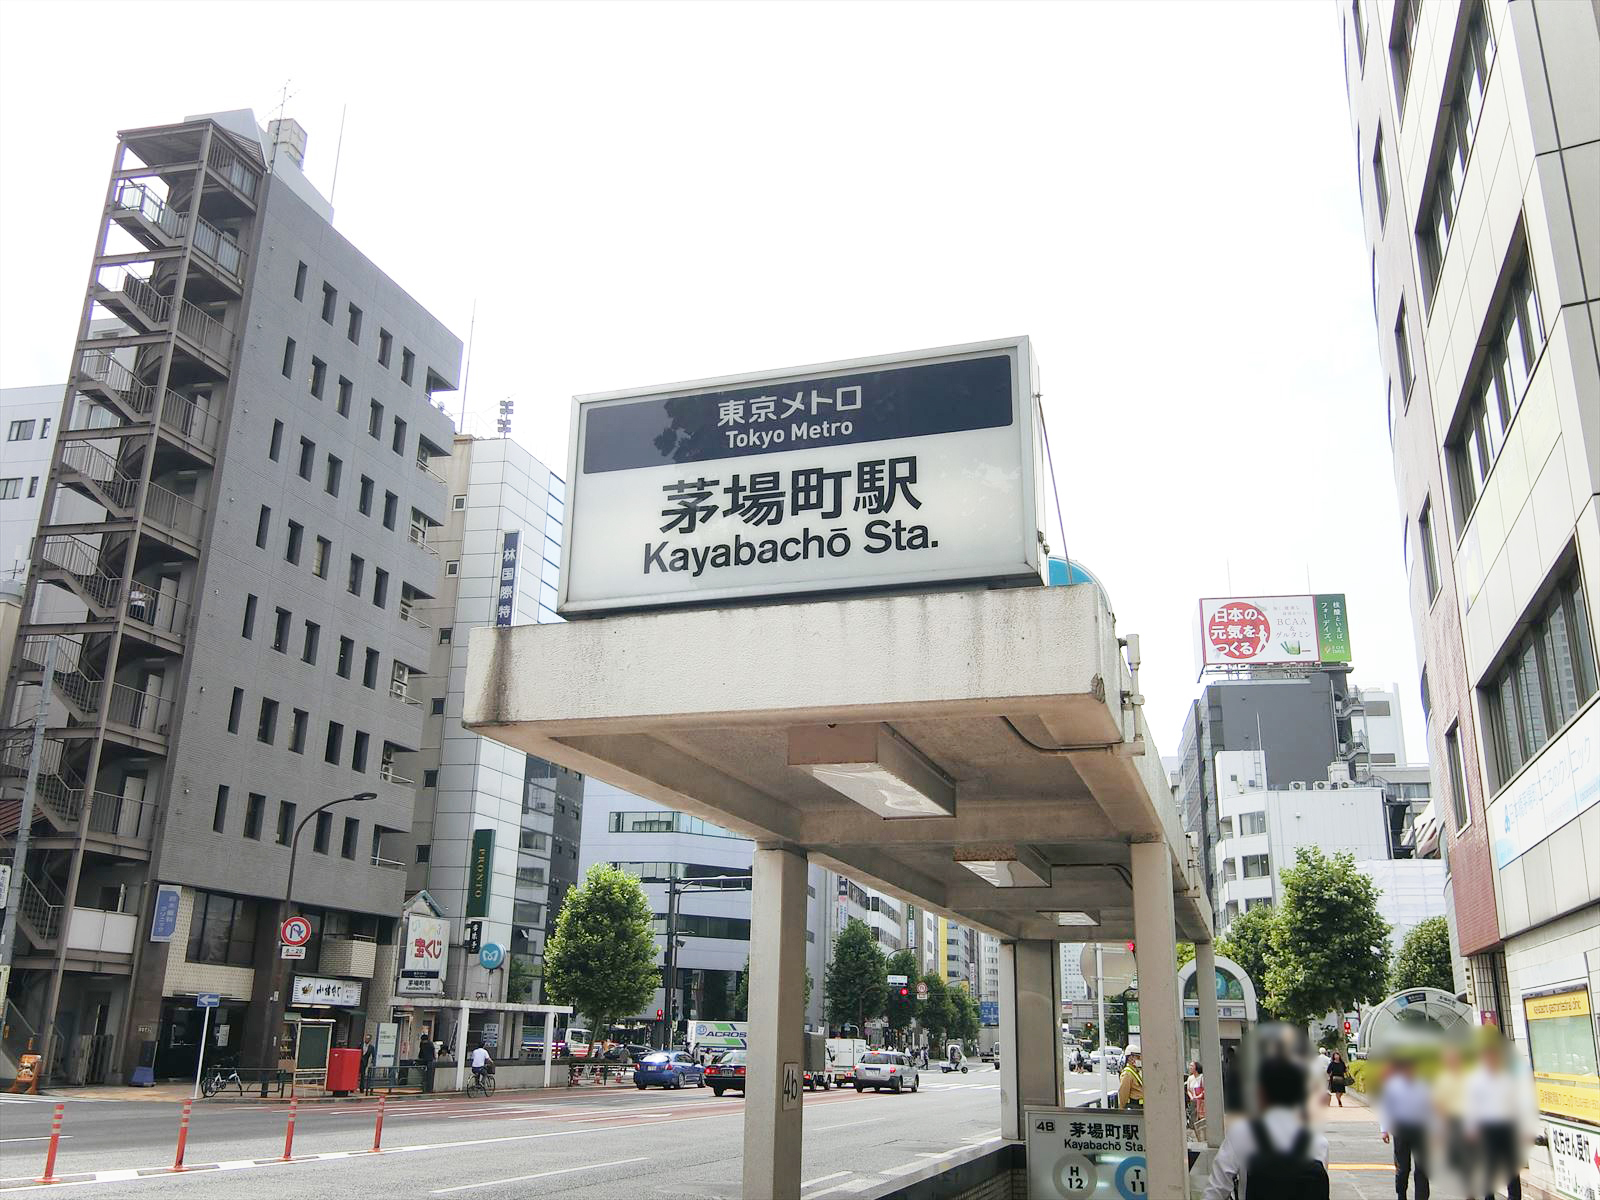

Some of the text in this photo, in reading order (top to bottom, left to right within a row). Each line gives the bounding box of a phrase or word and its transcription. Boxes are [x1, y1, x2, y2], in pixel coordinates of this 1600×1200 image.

[718, 385, 862, 428] 東京メトロ
[726, 421, 853, 449] Tokyo Metro
[660, 455, 922, 534] 茅場町駅
[644, 519, 939, 577] Kayabachō Sta.
[498, 548, 516, 627] 林国際特
[1214, 608, 1265, 623] 日本の、
[1277, 617, 1307, 626] BCAA
[1211, 625, 1256, 640] 元気を
[1276, 631, 1312, 639] グルタミン
[1215, 641, 1254, 656] つくる
[474, 847, 486, 898] PRONTO
[415, 938, 442, 959] 宝くじ
[784, 1069, 797, 1102] 4b
[1036, 1121, 1055, 1132] 4B
[1070, 1122, 1140, 1141] 茅場町駅
[1125, 1141, 1146, 1152] Sta.
[1070, 1166, 1079, 1177] H
[1134, 1169, 1141, 1180] T
[1067, 1177, 1084, 1190] 12
[1131, 1181, 1146, 1193] 11
